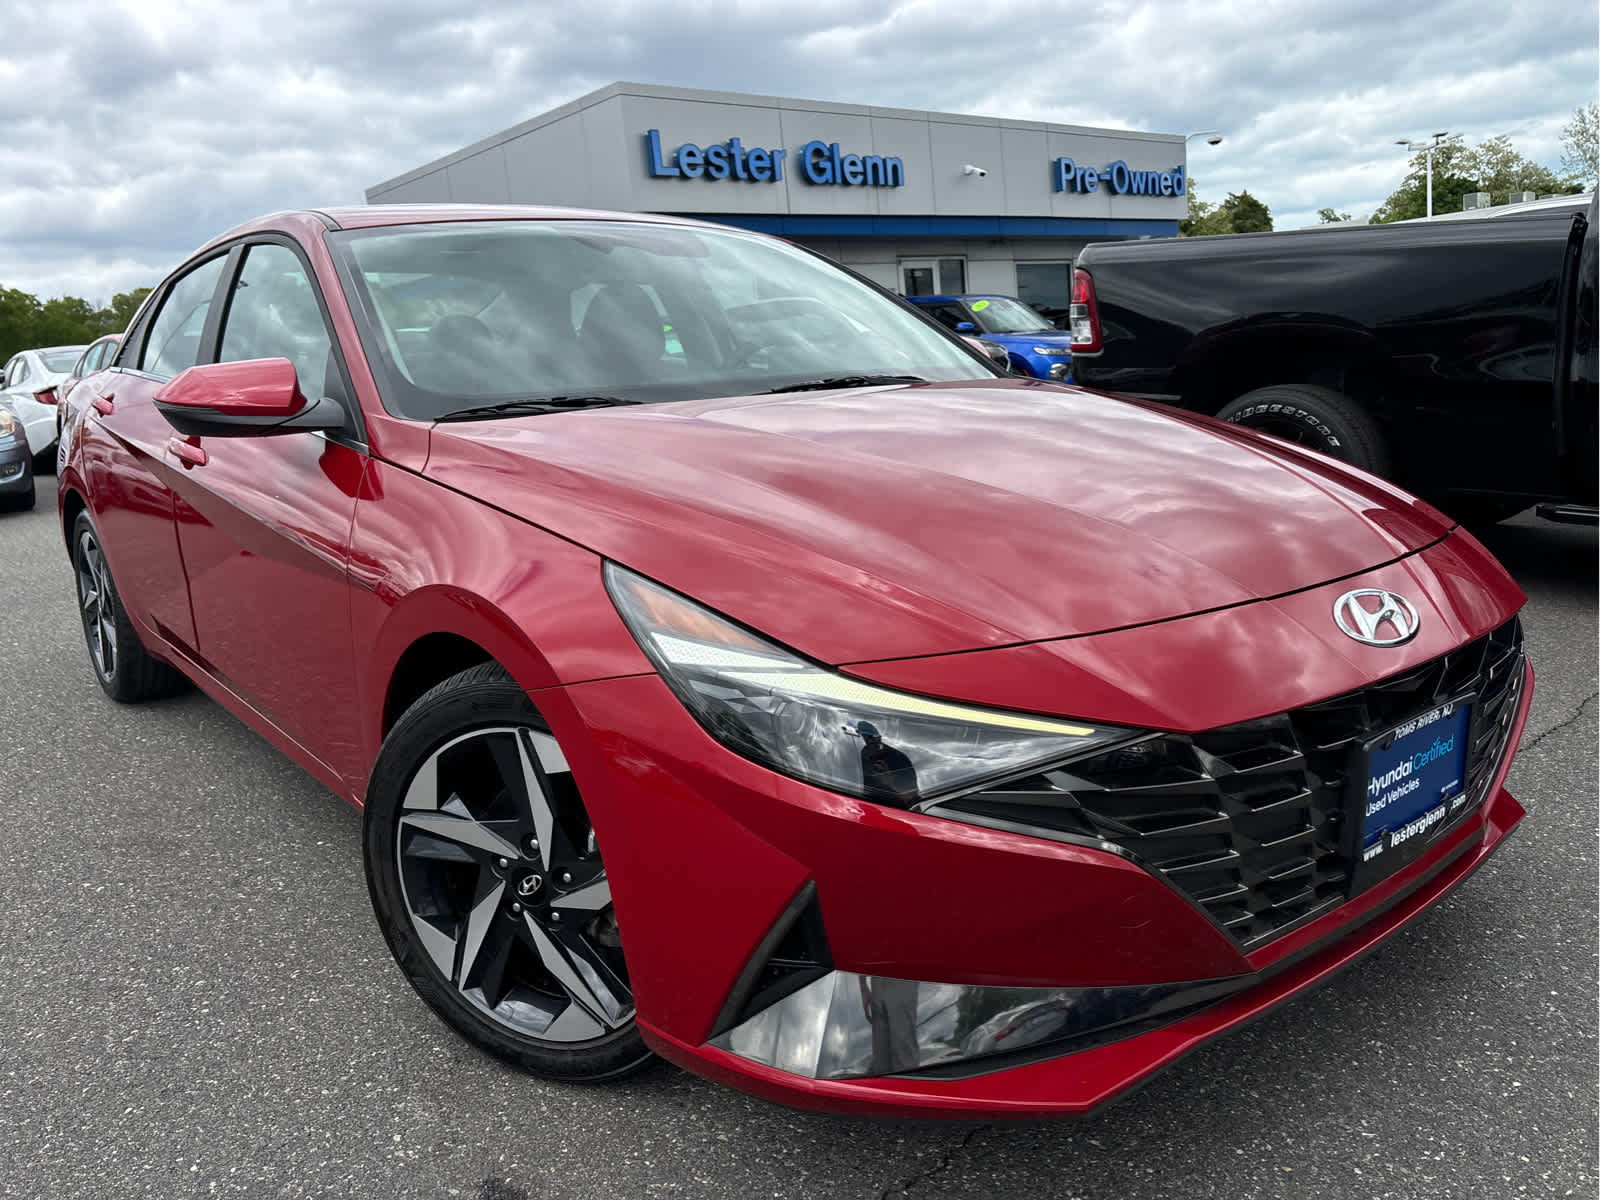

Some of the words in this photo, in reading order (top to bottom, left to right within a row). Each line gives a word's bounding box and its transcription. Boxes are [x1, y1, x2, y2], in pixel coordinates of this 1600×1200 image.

[647, 128, 787, 181] Lester
[803, 140, 905, 187] Glenn
[1056, 157, 1186, 196] Pre-Owned
[1367, 756, 1413, 797] Hyundai
[1413, 733, 1454, 770] Certified
[1366, 793, 1387, 817] Used
[1387, 778, 1420, 804] Vehicles
[1391, 806, 1445, 848] lesterglenn
